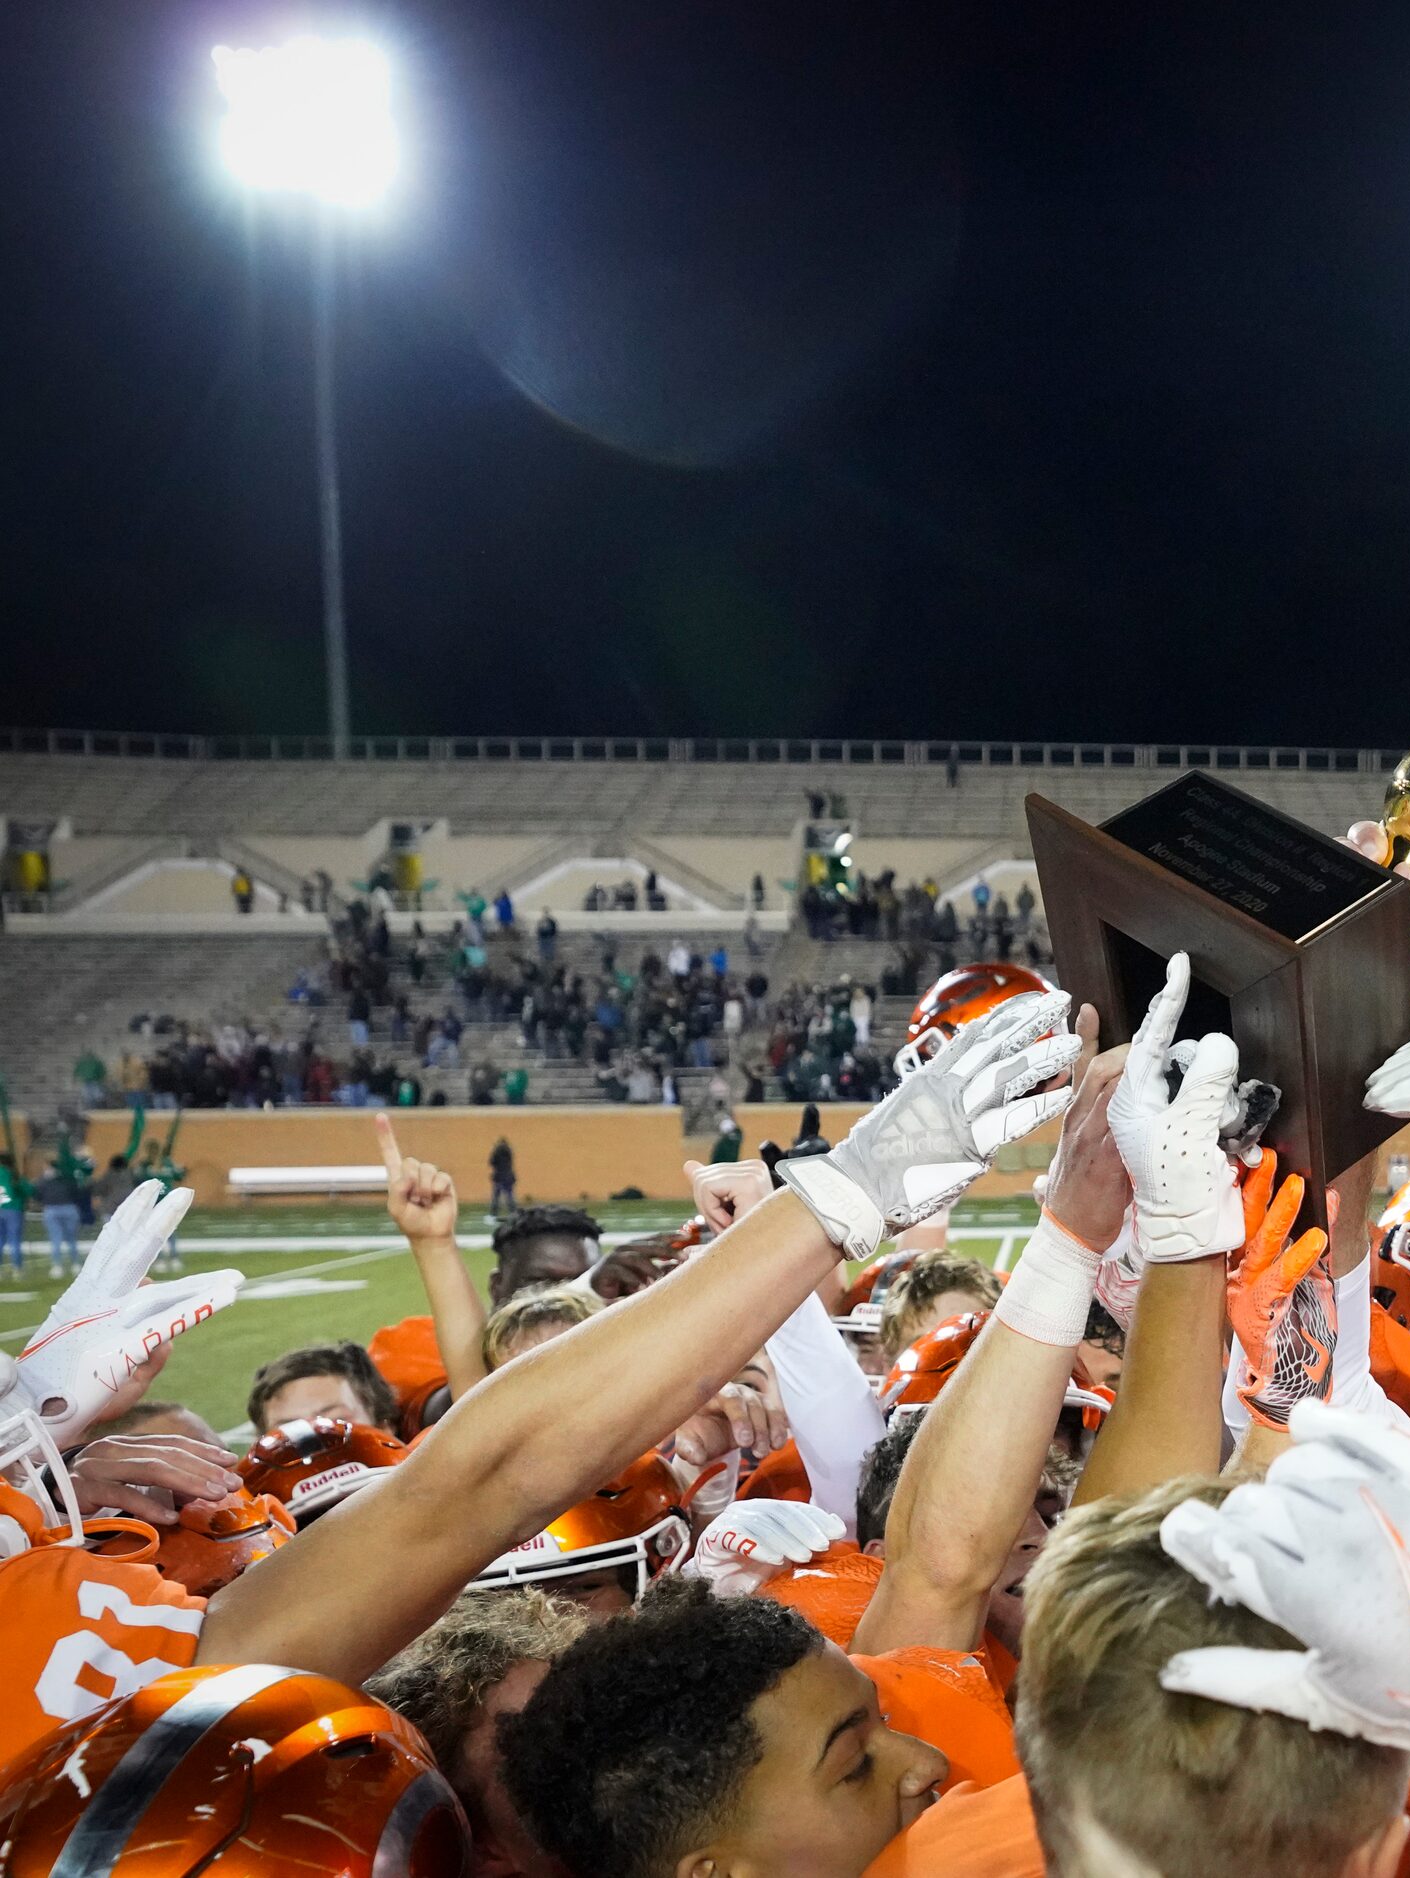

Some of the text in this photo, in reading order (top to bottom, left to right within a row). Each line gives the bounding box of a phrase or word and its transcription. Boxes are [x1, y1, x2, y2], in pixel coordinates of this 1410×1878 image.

[1177, 833, 1281, 896] Apogee Stadium
[1178, 808, 1328, 894] Regional Championship
[1187, 786, 1222, 810] Class
[1307, 851, 1356, 883] Region
[1148, 842, 1214, 882] November
[1231, 890, 1268, 913] 2020
[299, 1463, 361, 1494] Riddell
